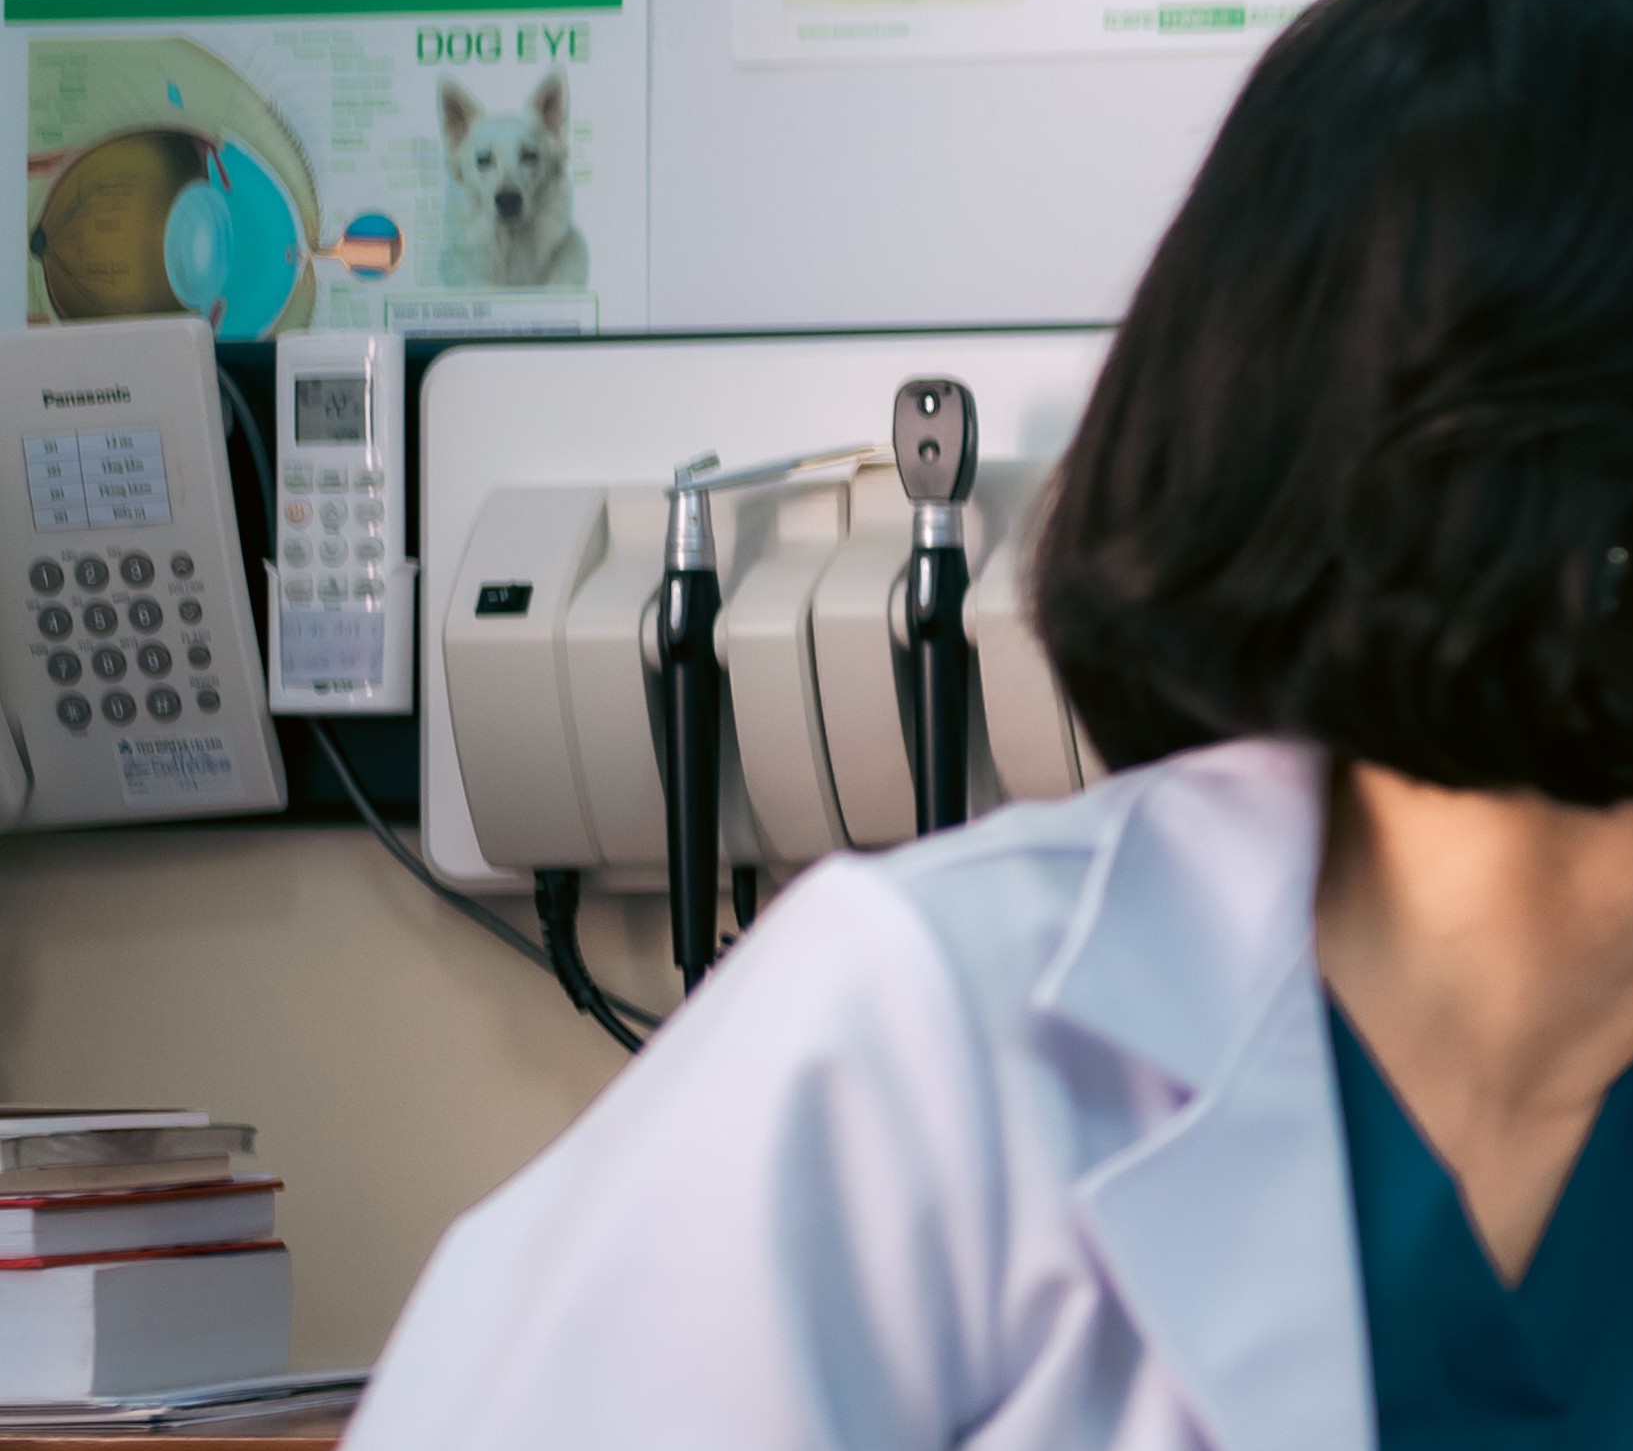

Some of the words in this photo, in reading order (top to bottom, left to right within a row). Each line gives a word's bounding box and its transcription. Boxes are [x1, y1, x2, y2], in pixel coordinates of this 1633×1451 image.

[417, 26, 501, 64] DOG
[517, 22, 590, 62] EYE
[42, 386, 131, 408] Panasonic
